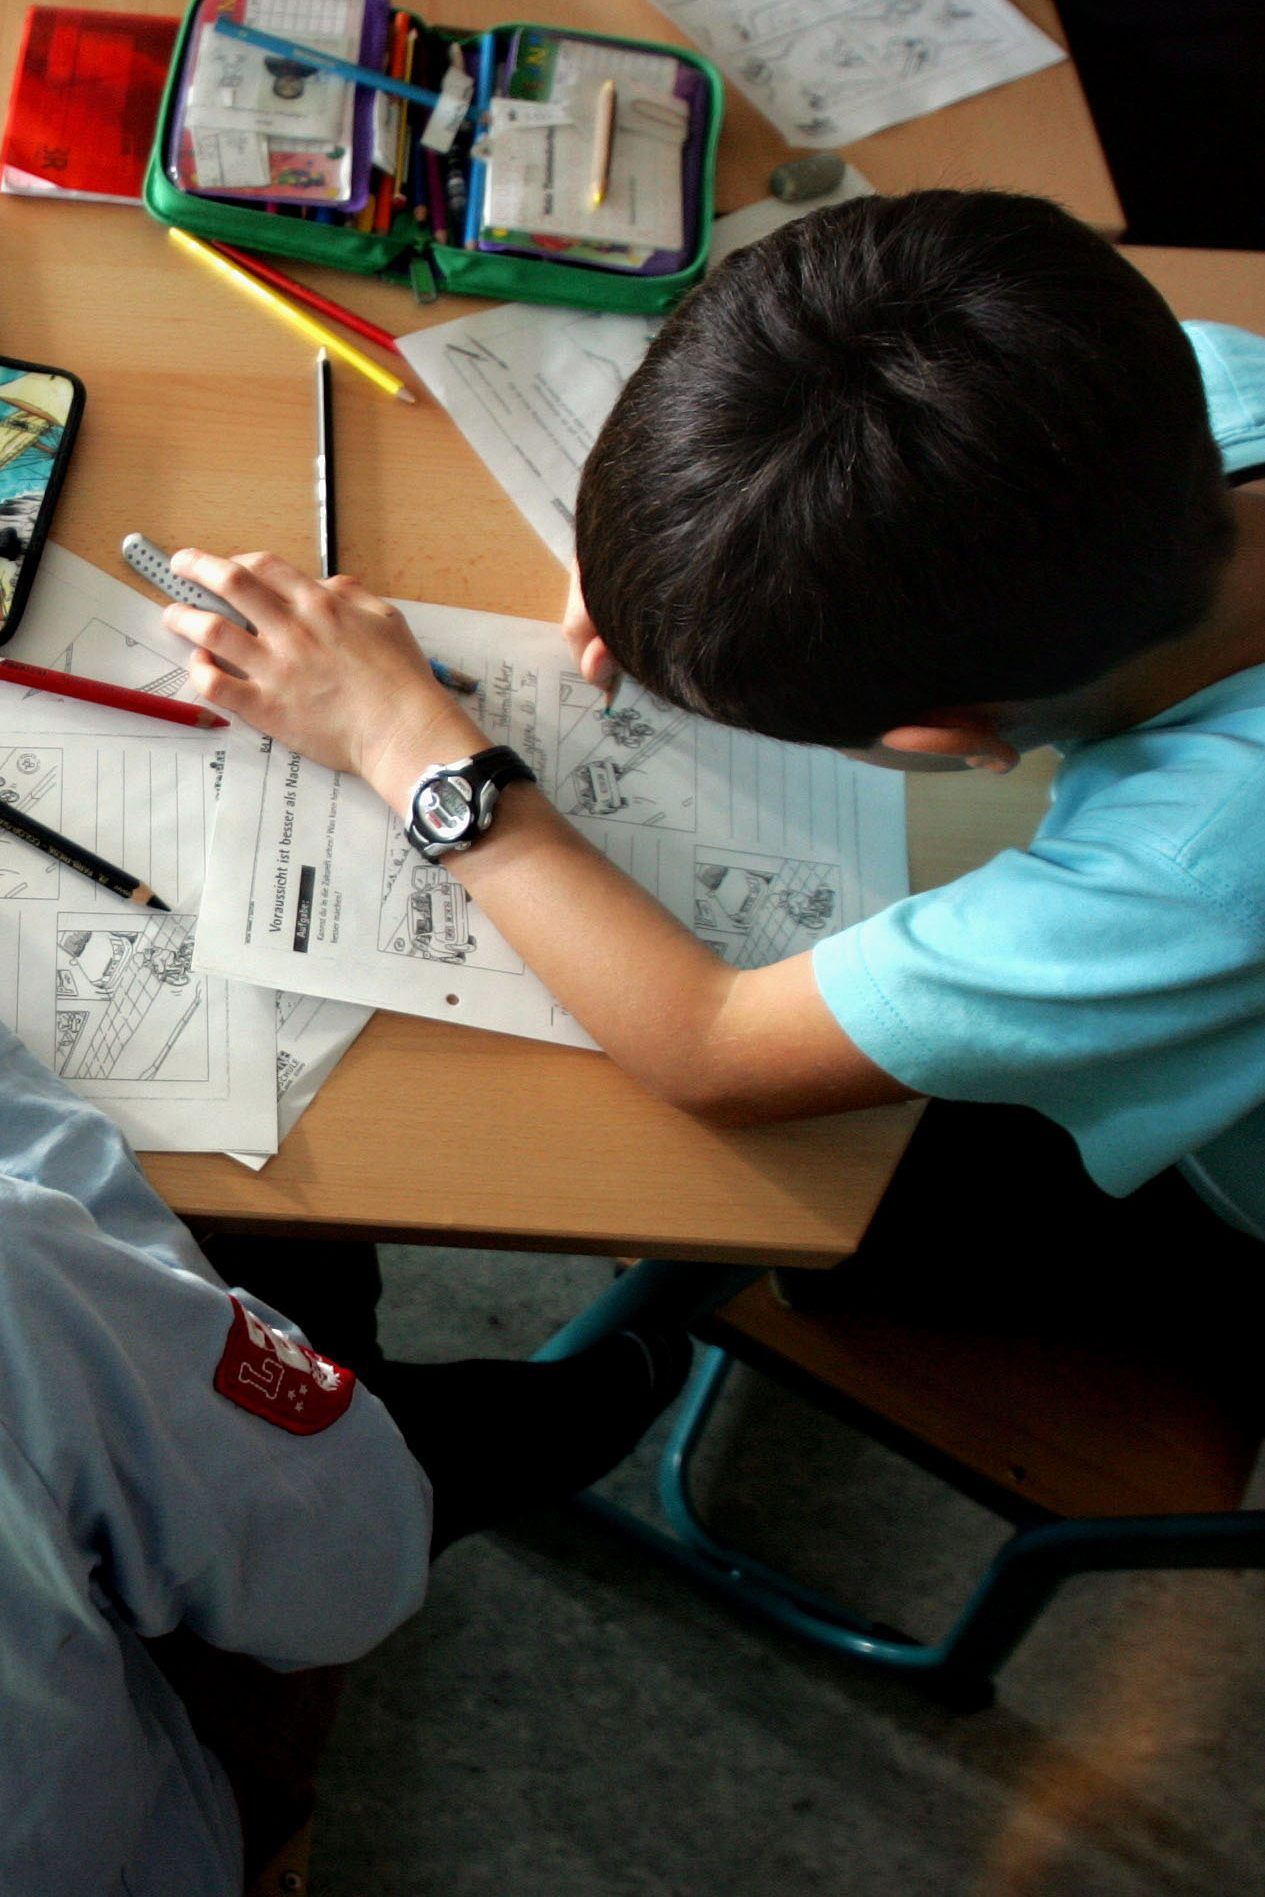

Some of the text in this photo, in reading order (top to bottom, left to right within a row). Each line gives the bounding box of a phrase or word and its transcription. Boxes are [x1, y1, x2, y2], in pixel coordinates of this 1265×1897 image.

[284, 792, 296, 807] als
[279, 810, 294, 846] besser
[277, 849, 290, 864] ist
[268, 867, 288, 933] Voraussicht
